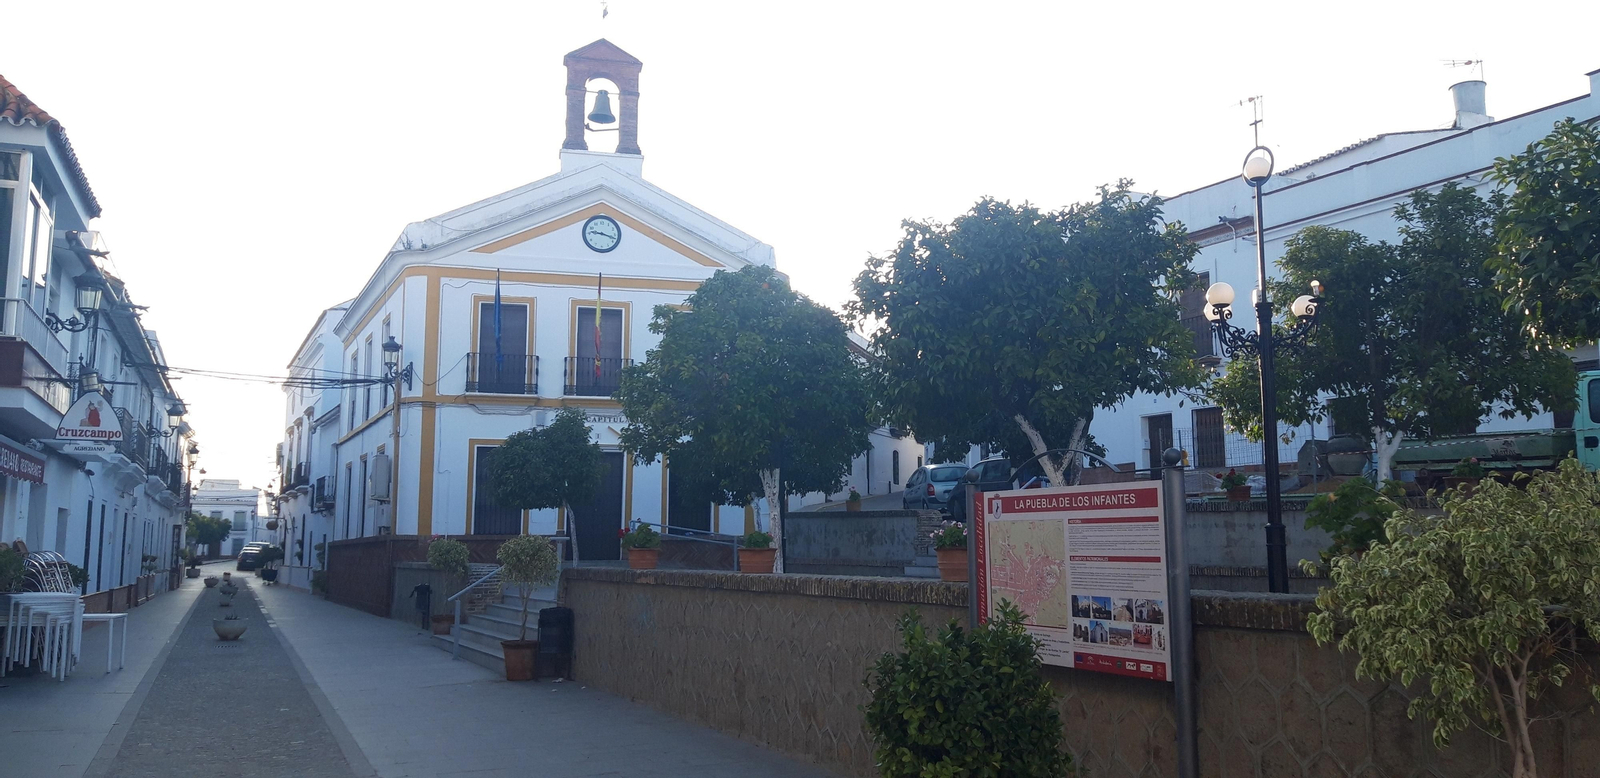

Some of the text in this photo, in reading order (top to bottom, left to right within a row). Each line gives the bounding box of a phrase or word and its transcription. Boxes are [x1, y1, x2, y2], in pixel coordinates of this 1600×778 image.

[58, 427, 122, 440] Cruzcampo
[1014, 493, 1136, 509] LA PUEBLA DE LOS INFANTES
[975, 501, 983, 563] Localidad
